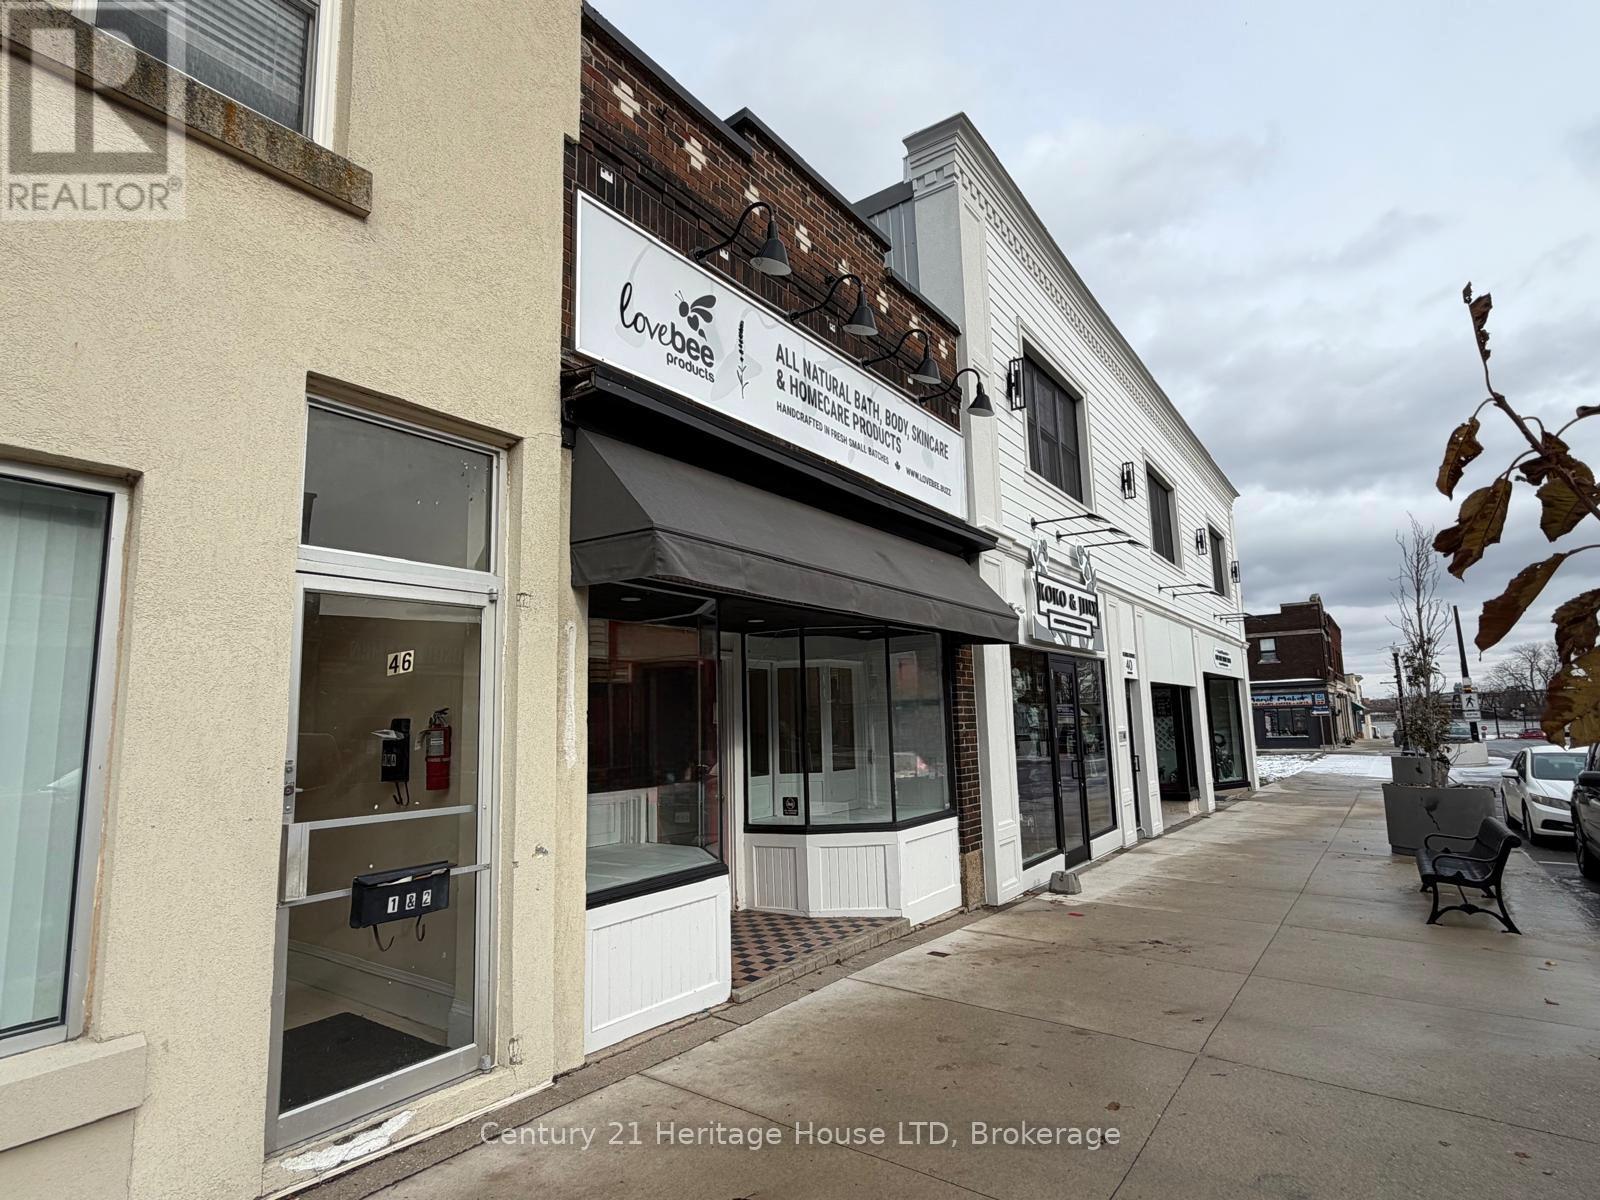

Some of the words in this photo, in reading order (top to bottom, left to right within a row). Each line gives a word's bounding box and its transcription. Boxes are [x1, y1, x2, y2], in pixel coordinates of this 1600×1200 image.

[666, 352, 715, 383] products
[776, 344, 799, 373] ALL
[803, 357, 851, 405] NATURAL
[854, 389, 882, 425] BATH,
[885, 408, 909, 440] BODY,
[911, 425, 949, 460] SKINCARE
[776, 369, 785, 391] &
[789, 375, 850, 427] HOMECARE
[853, 413, 902, 454] PRODUCTS
[776, 401, 823, 431] HANDCRAFTED
[824, 424, 830, 435] IN
[831, 428, 848, 446] FRESH
[849, 438, 867, 454] SMALL
[868, 446, 889, 464] BATCHES
[1037, 582, 1067, 608] KOKO
[1069, 594, 1077, 611] &
[388, 652, 412, 673] 46
